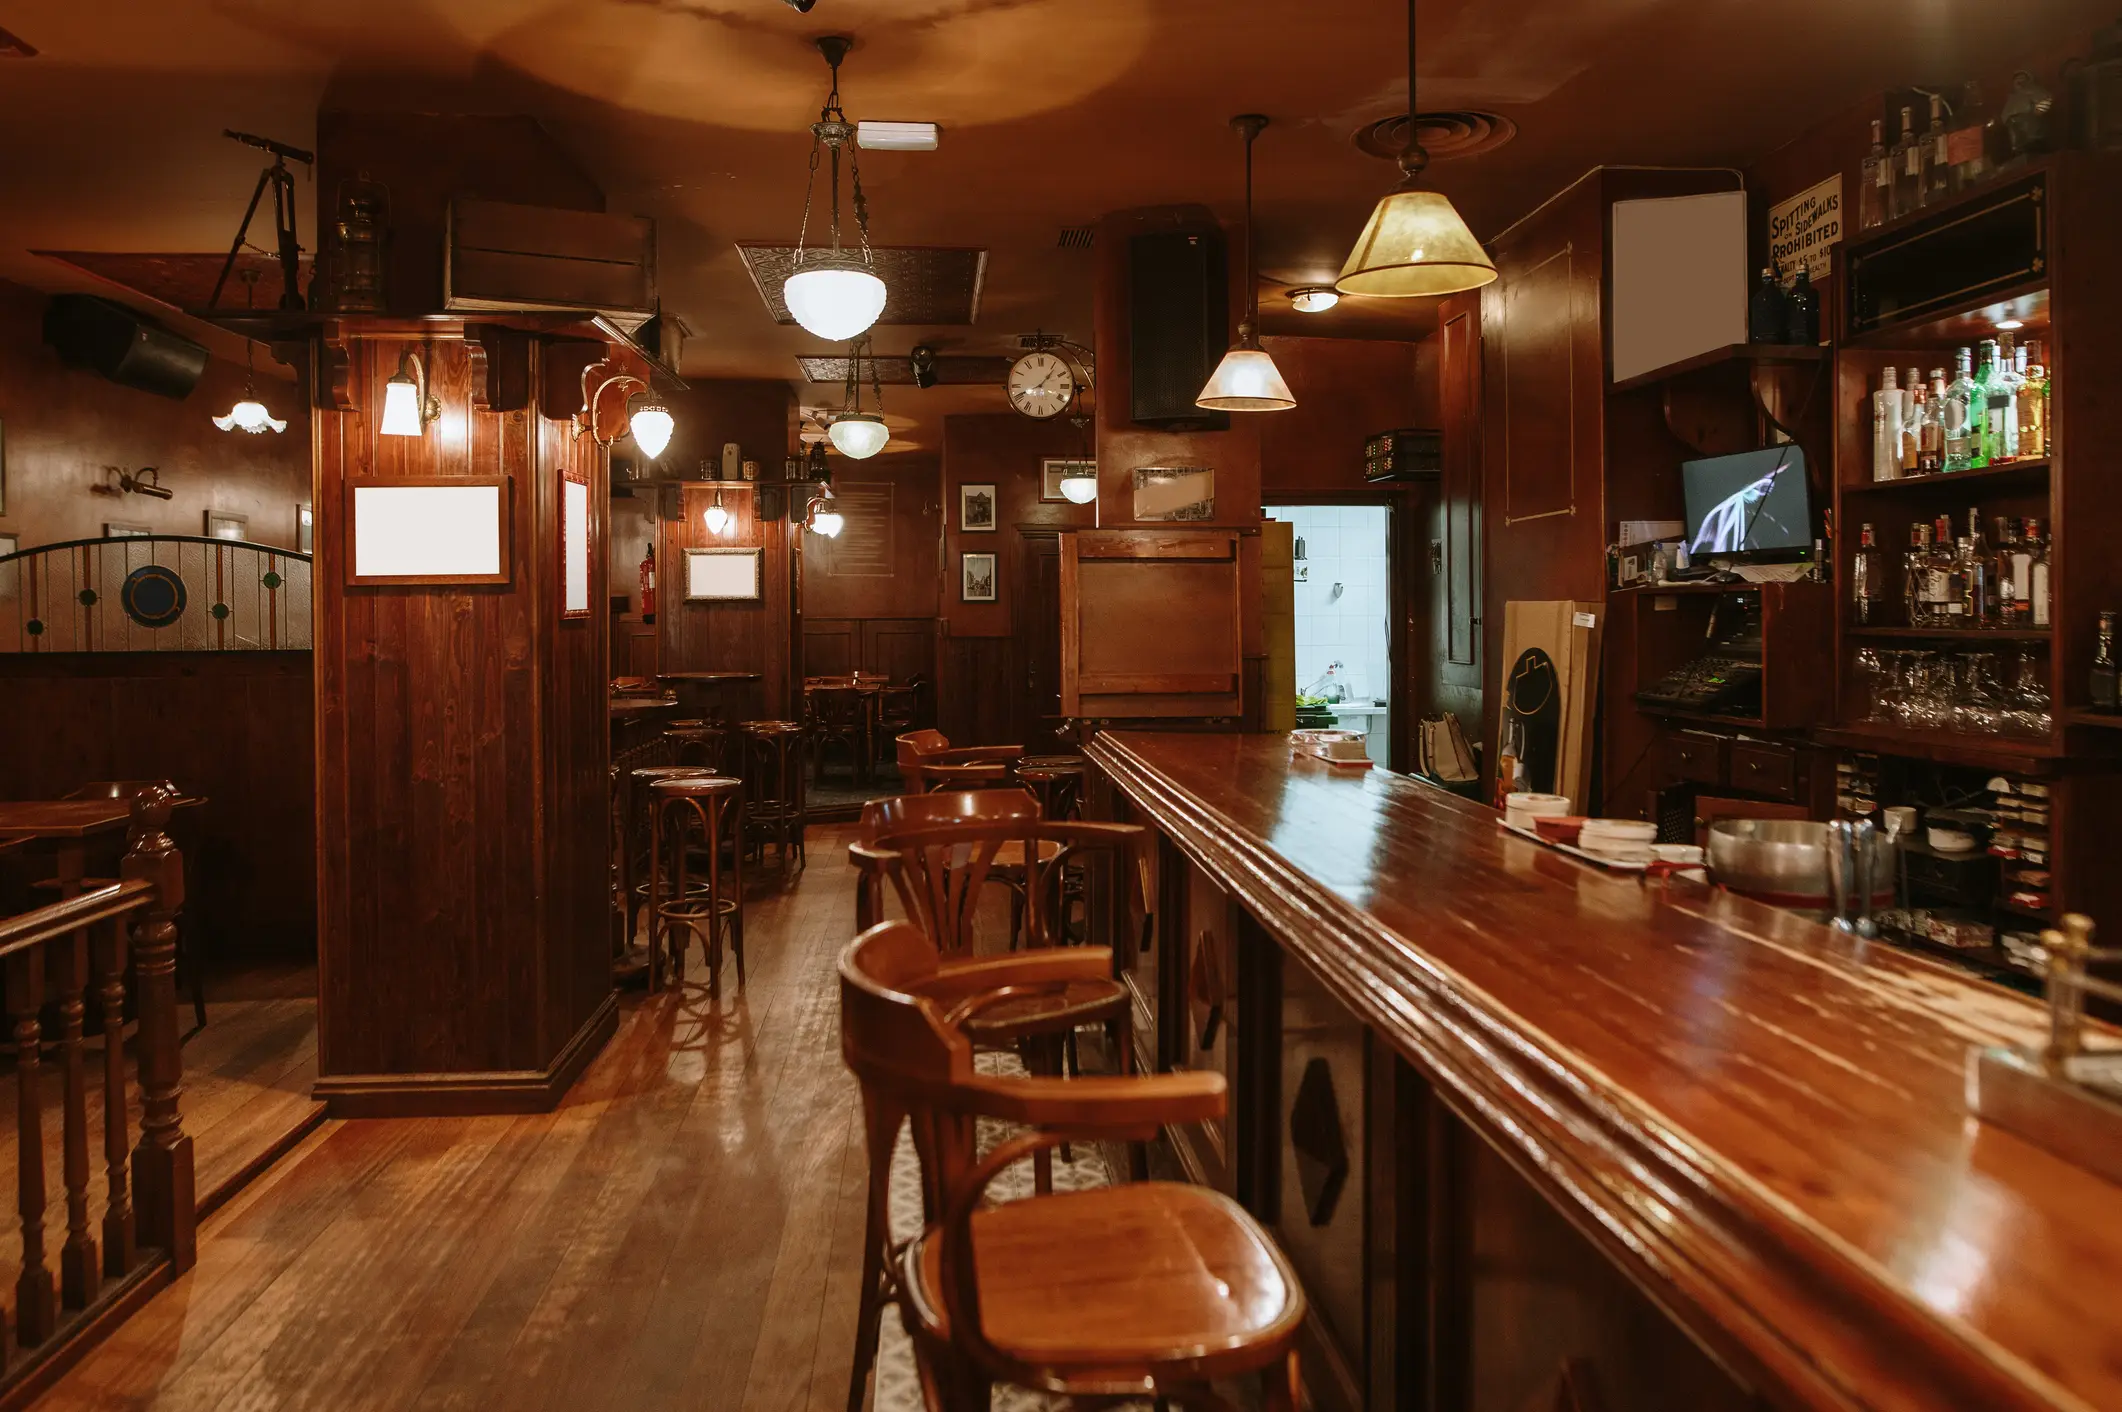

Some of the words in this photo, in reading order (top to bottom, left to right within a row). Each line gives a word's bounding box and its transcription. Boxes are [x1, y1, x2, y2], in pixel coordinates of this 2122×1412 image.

[1772, 196, 1817, 239] SPITTING
[1795, 195, 1838, 235] SIDEWALKS
[1772, 221, 1838, 258] PROHIBITED
